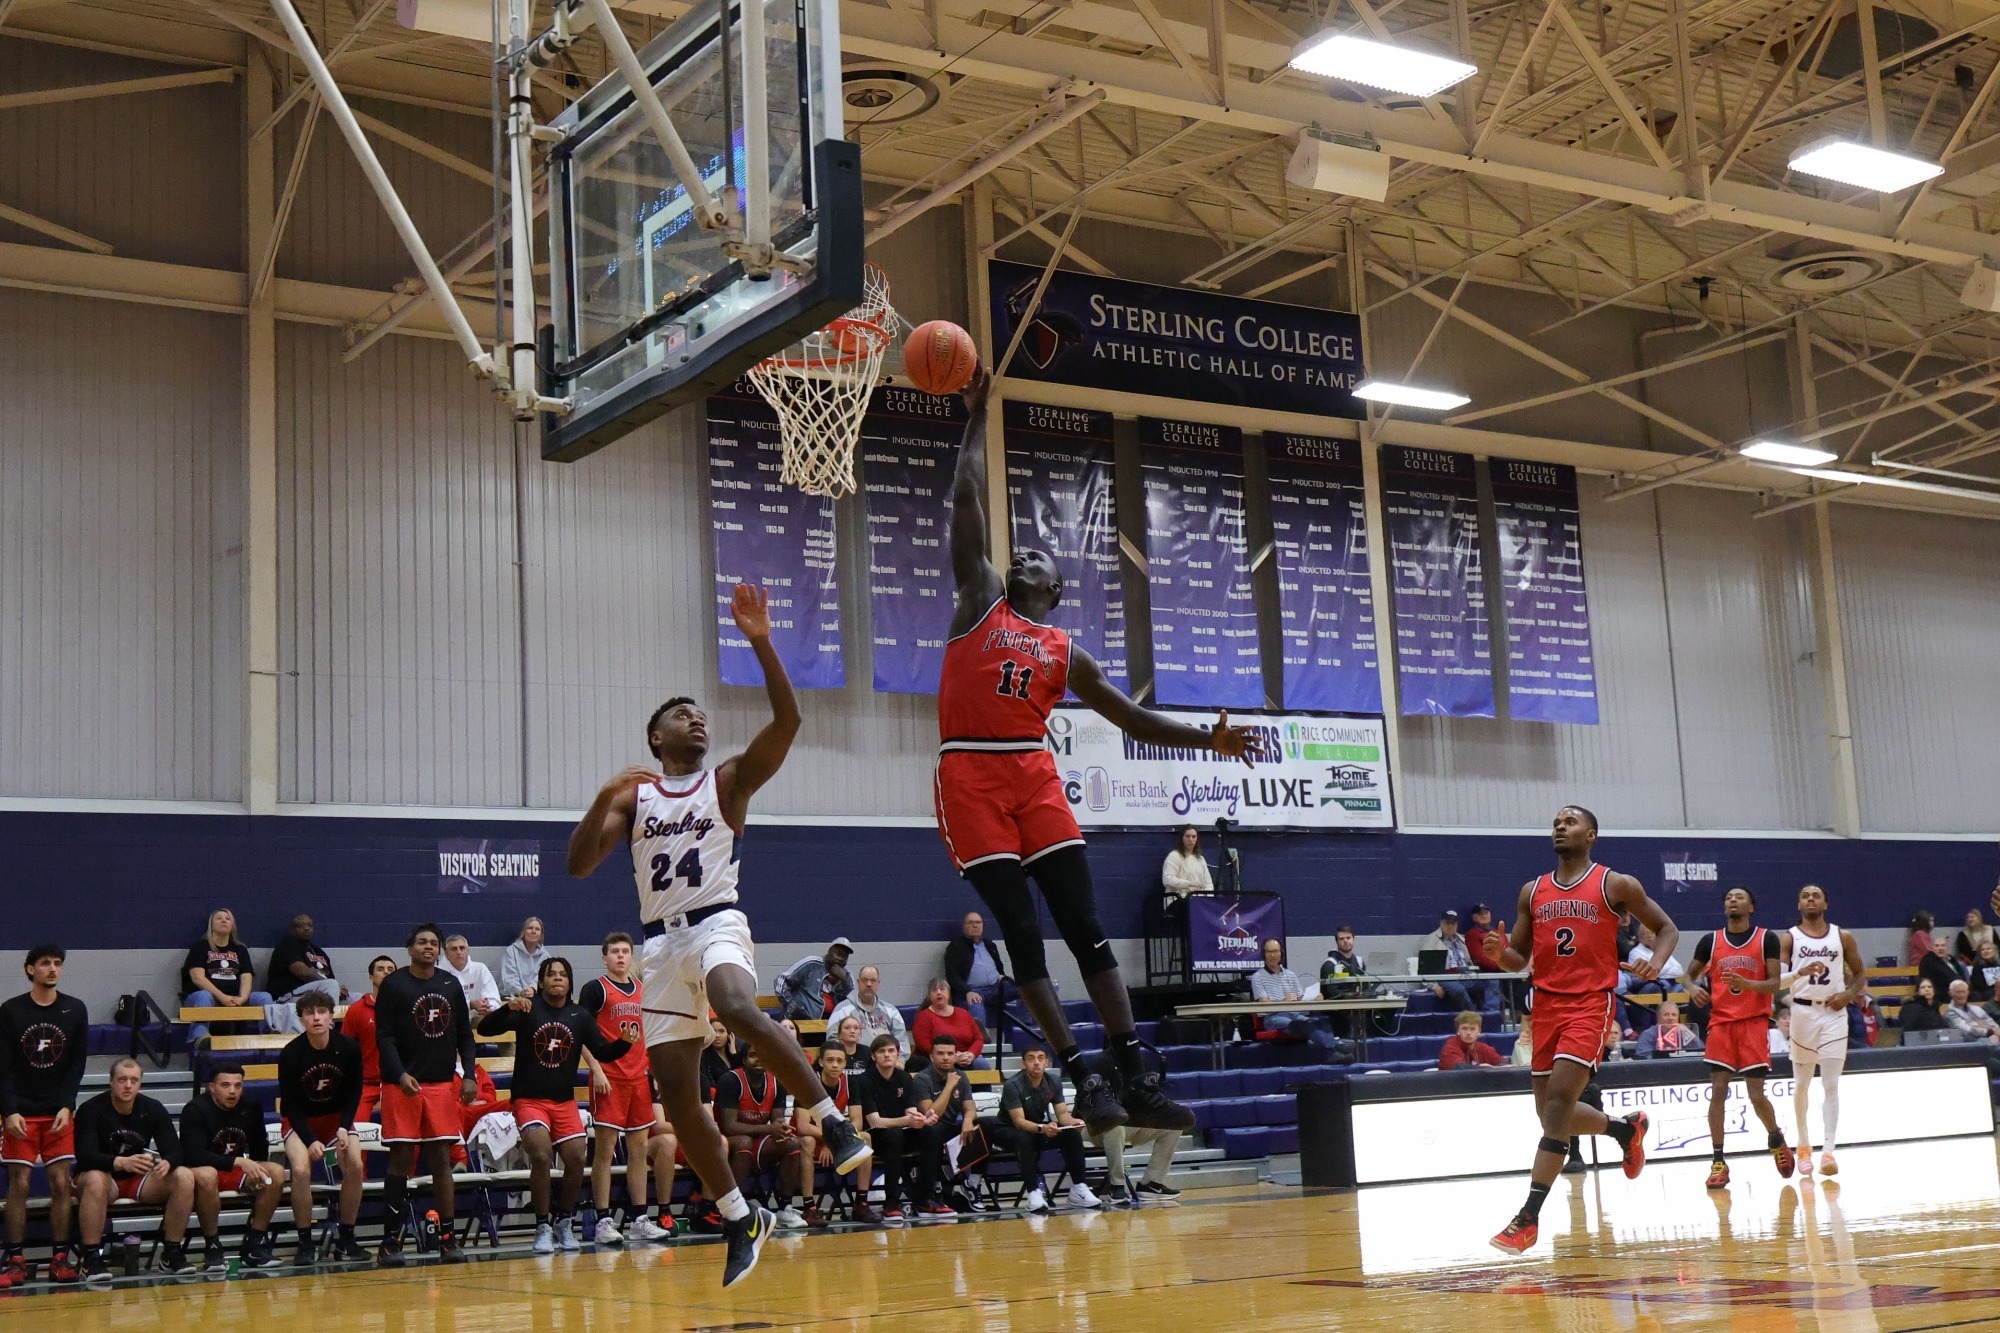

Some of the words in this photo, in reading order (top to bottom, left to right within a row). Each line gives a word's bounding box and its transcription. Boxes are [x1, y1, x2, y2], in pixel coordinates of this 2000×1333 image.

[1092, 341, 1200, 370] ATHLETIC
[1210, 356, 1263, 379] HALL
[1271, 364, 1296, 383] OF
[1304, 368, 1357, 390] FAME
[886, 390, 950, 406] STERLING
[886, 400, 951, 416] COLLEGE
[1029, 406, 1089, 422] STERLING
[1030, 416, 1089, 432] COLLEGE
[1162, 422, 1219, 437] STERLING
[892, 436, 931, 447] INDUCTED
[933, 441, 949, 449] 1994
[1163, 433, 1219, 447] COLLEGE
[1286, 437, 1339, 450] STERLING
[1035, 451, 1070, 462] INDUCTED
[1287, 446, 1340, 460] COLLEGE
[1404, 450, 1454, 464] STERLING
[1168, 466, 1202, 476] INDUCTED
[1405, 460, 1455, 473] COLLEGE
[1508, 463, 1556, 476] STERLING
[1292, 479, 1324, 488] INDUCTED
[1510, 472, 1557, 484] COLLEGE
[1410, 491, 1440, 500] INDUCTED
[1298, 566, 1331, 575] INDUCTED
[1177, 607, 1211, 616] INDUCTED
[996, 659, 1034, 700] 11
[1302, 726, 1321, 741] RICE
[1323, 727, 1377, 742] COMMUNITY
[1112, 780, 1135, 798] First
[1139, 780, 1169, 798] Bank
[1172, 775, 1240, 816] Sterling
[1242, 778, 1314, 808] LUXE
[644, 811, 714, 840] Sterling
[440, 853, 487, 876] VISITOR
[490, 854, 539, 877] SEATING
[651, 848, 703, 891] 24
[1664, 862, 1686, 880] HOME
[1687, 862, 1718, 880] SEATING
[1535, 899, 1599, 928] FRIENDS
[1218, 936, 1258, 950] STERLING
[1555, 927, 1576, 957] 2
[1799, 946, 1839, 962] Sterling
[428, 1009, 439, 1021] F
[548, 1039, 561, 1051] F
[317, 1079, 330, 1090] F
[1601, 1086, 1699, 1108] TERLING
[1704, 1081, 1795, 1106] CLGE
